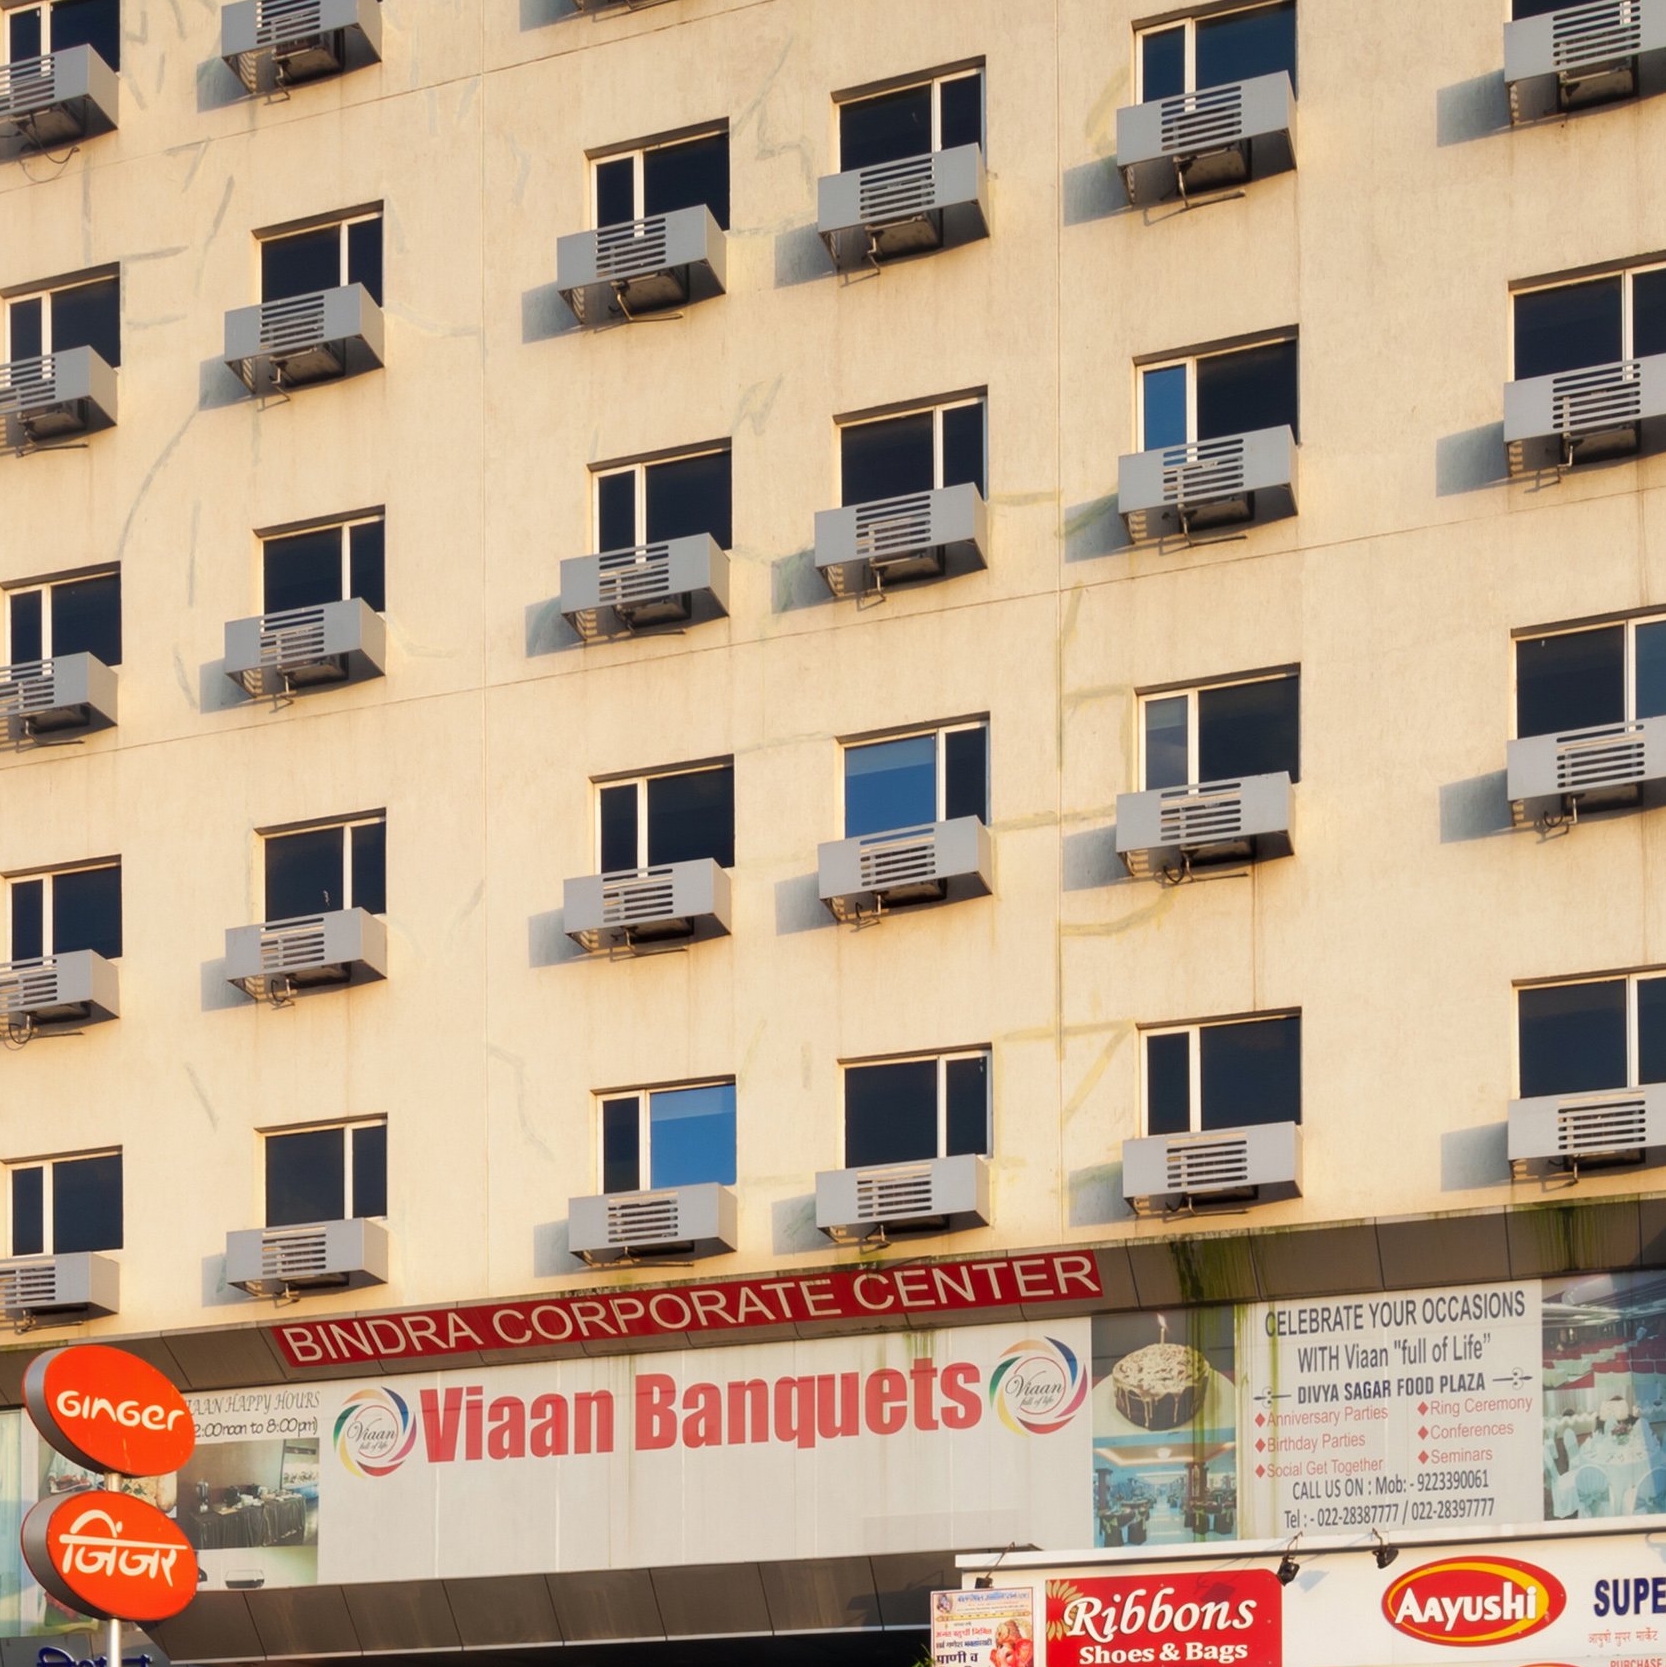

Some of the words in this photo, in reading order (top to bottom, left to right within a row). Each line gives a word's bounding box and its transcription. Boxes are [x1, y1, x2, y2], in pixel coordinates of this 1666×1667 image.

[282, 1311, 482, 1364] BINDRA
[492, 1280, 841, 1346] CORPORATE
[852, 1255, 1100, 1310] CENTER
[1265, 1301, 1363, 1337] CELEBRATE
[1369, 1297, 1416, 1327] YOUR
[1422, 1290, 1525, 1324] OCCASIONS
[1298, 1345, 1338, 1372] WITH
[1345, 1342, 1387, 1370] Viaan
[1431, 1338, 1449, 1363] of
[1005, 1370, 1062, 1397] Viaan
[1298, 1382, 1338, 1404] DIVYA
[1344, 1379, 1391, 1401] SAGAR
[1397, 1376, 1434, 1398] FOOD
[1440, 1372, 1486, 1395] PLAZA
[225, 1393, 272, 1415] HAPPY
[274, 1390, 320, 1410] HOURS
[419, 1385, 614, 1464] Viaan
[635, 1357, 983, 1451] Banquets
[1267, 1406, 1339, 1428] Anniversary
[1343, 1404, 1388, 1424] Parties
[1430, 1399, 1459, 1419] Ring
[1464, 1395, 1533, 1416] Ceremony
[1267, 1435, 1318, 1454] Birthday
[1322, 1432, 1365, 1450] Parties
[1431, 1422, 1513, 1440] Conferences
[1267, 1463, 1302, 1478] Social
[1305, 1460, 1327, 1476] Get
[1331, 1456, 1383, 1477] Together
[1431, 1447, 1492, 1464] Seminars
[1293, 1480, 1323, 1500] CALL
[1327, 1479, 1340, 1498] US
[1346, 1478, 1363, 1497] ON
[1418, 1470, 1488, 1492] 9223390061
[1316, 1504, 1398, 1527] 022-28387777
[1413, 1499, 1494, 1522] 022-28397777
[59, 1510, 188, 1587] जिंजर
[1064, 1587, 1257, 1643] Ribbons
[1079, 1646, 1154, 1665] Shoes
[1159, 1643, 1180, 1662] &
[1185, 1642, 1248, 1664] Bags
